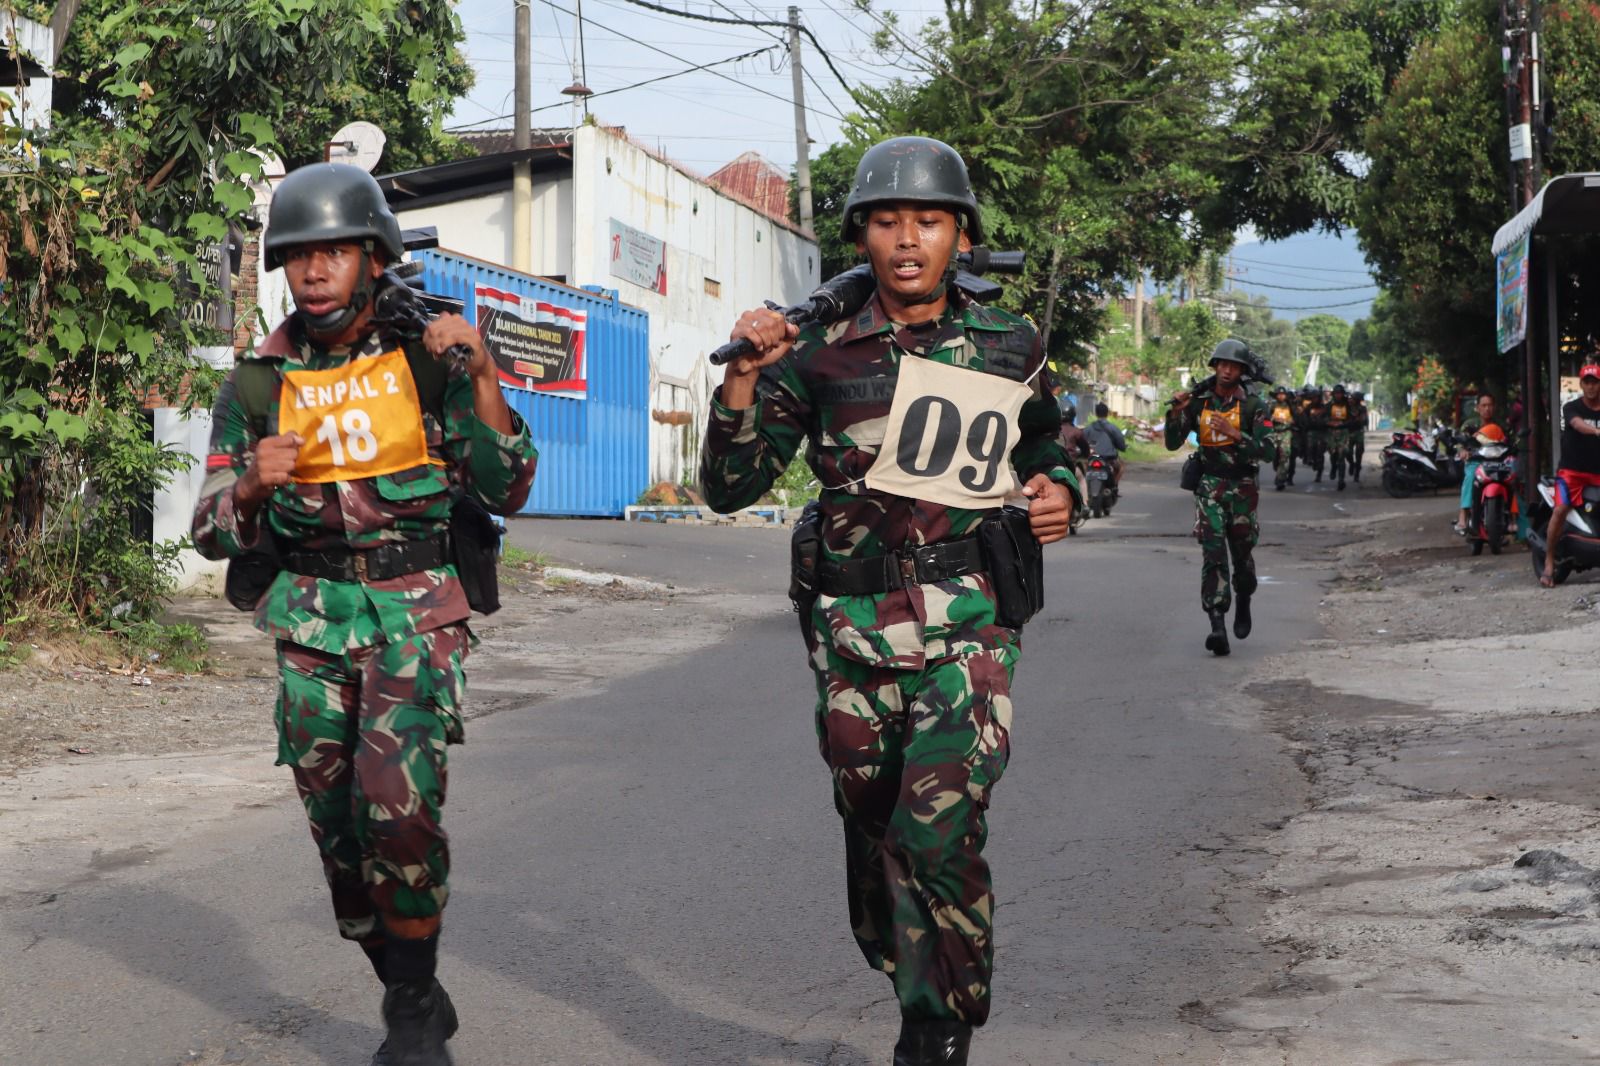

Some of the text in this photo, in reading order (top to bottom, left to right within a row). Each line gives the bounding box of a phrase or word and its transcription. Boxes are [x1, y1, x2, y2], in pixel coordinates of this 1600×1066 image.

[195, 243, 221, 263] SUPER
[384, 371, 399, 394] 2
[317, 408, 378, 466] 18
[896, 395, 1008, 493] 09
